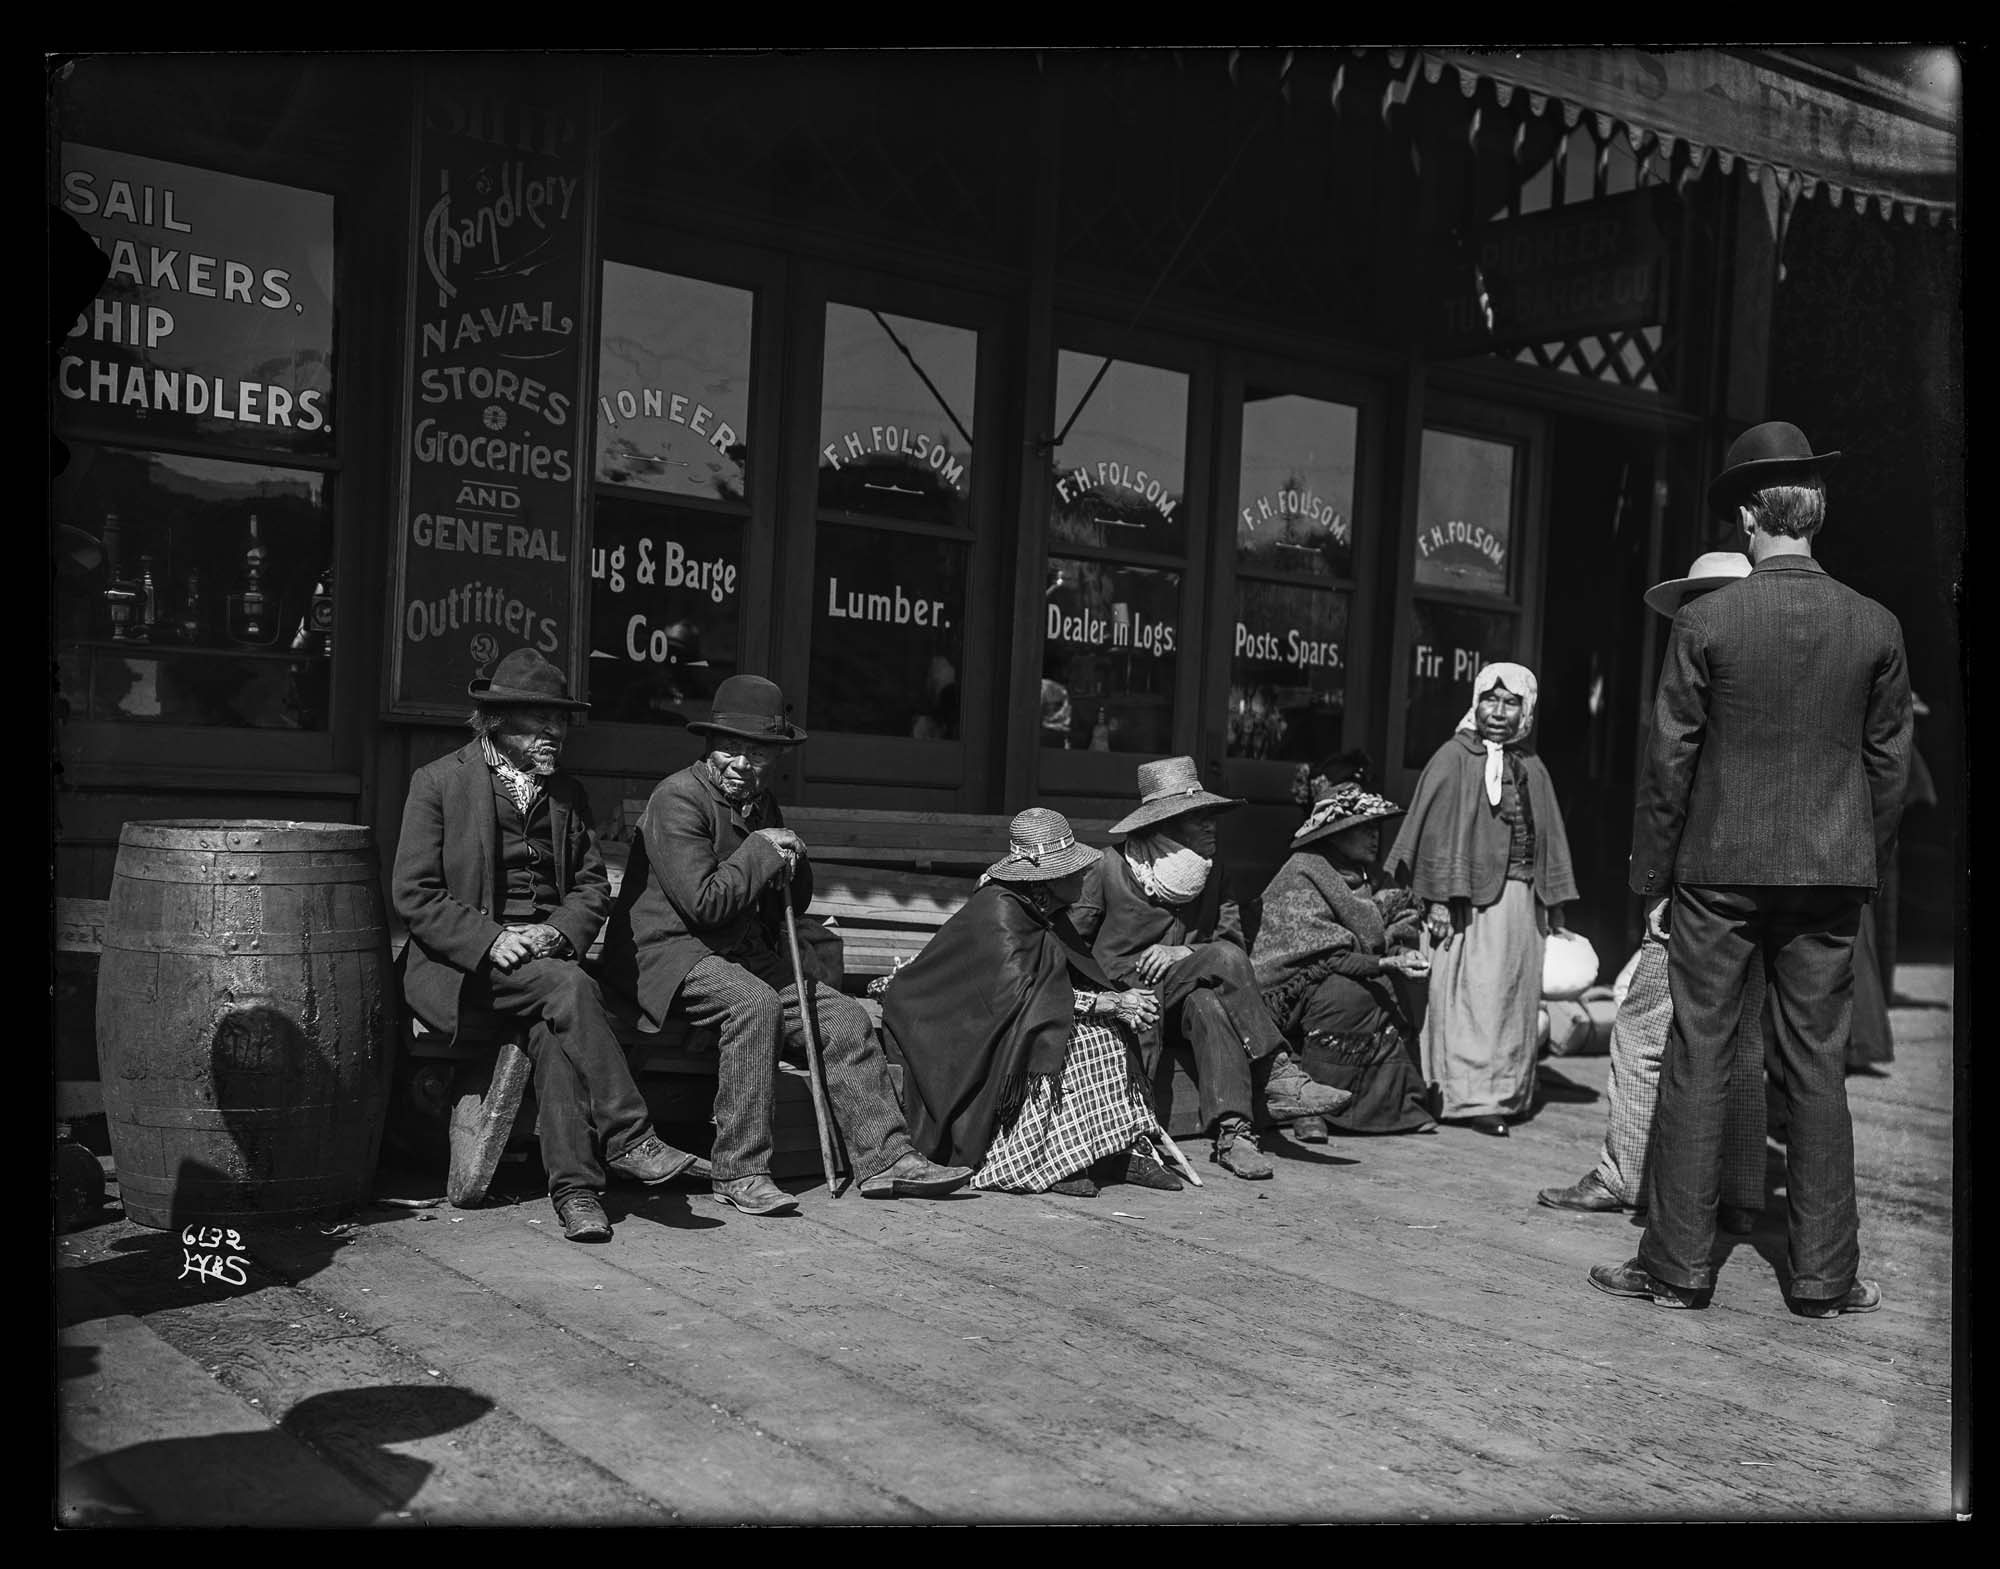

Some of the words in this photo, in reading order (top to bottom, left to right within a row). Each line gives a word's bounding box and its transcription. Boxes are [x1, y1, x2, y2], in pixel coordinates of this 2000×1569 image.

[63, 170, 193, 233] SAIL
[423, 161, 578, 308] Chandlery
[90, 236, 304, 316] AKERS,
[422, 301, 574, 358] NAVAL
[58, 355, 333, 433] CHANDLERS.
[420, 367, 571, 426] STORES
[600, 388, 737, 455] IONEER
[414, 418, 572, 482] Groceries
[455, 486, 521, 509] AND
[413, 513, 567, 563] GENERAL
[591, 544, 626, 593] ug
[636, 537, 656, 585] &
[664, 541, 737, 604] Barge
[406, 581, 559, 653] Outfitters
[828, 577, 951, 629] Lumber.
[1047, 602, 1108, 645] Dealer
[1112, 617, 1129, 647] in
[1133, 612, 1178, 658] Logs.
[626, 613, 678, 664] Co.
[1235, 621, 1284, 662] Posts.
[1286, 629, 1345, 670] Spars.
[1415, 644, 1445, 678] Fir
[1453, 647, 1490, 682] Pil
